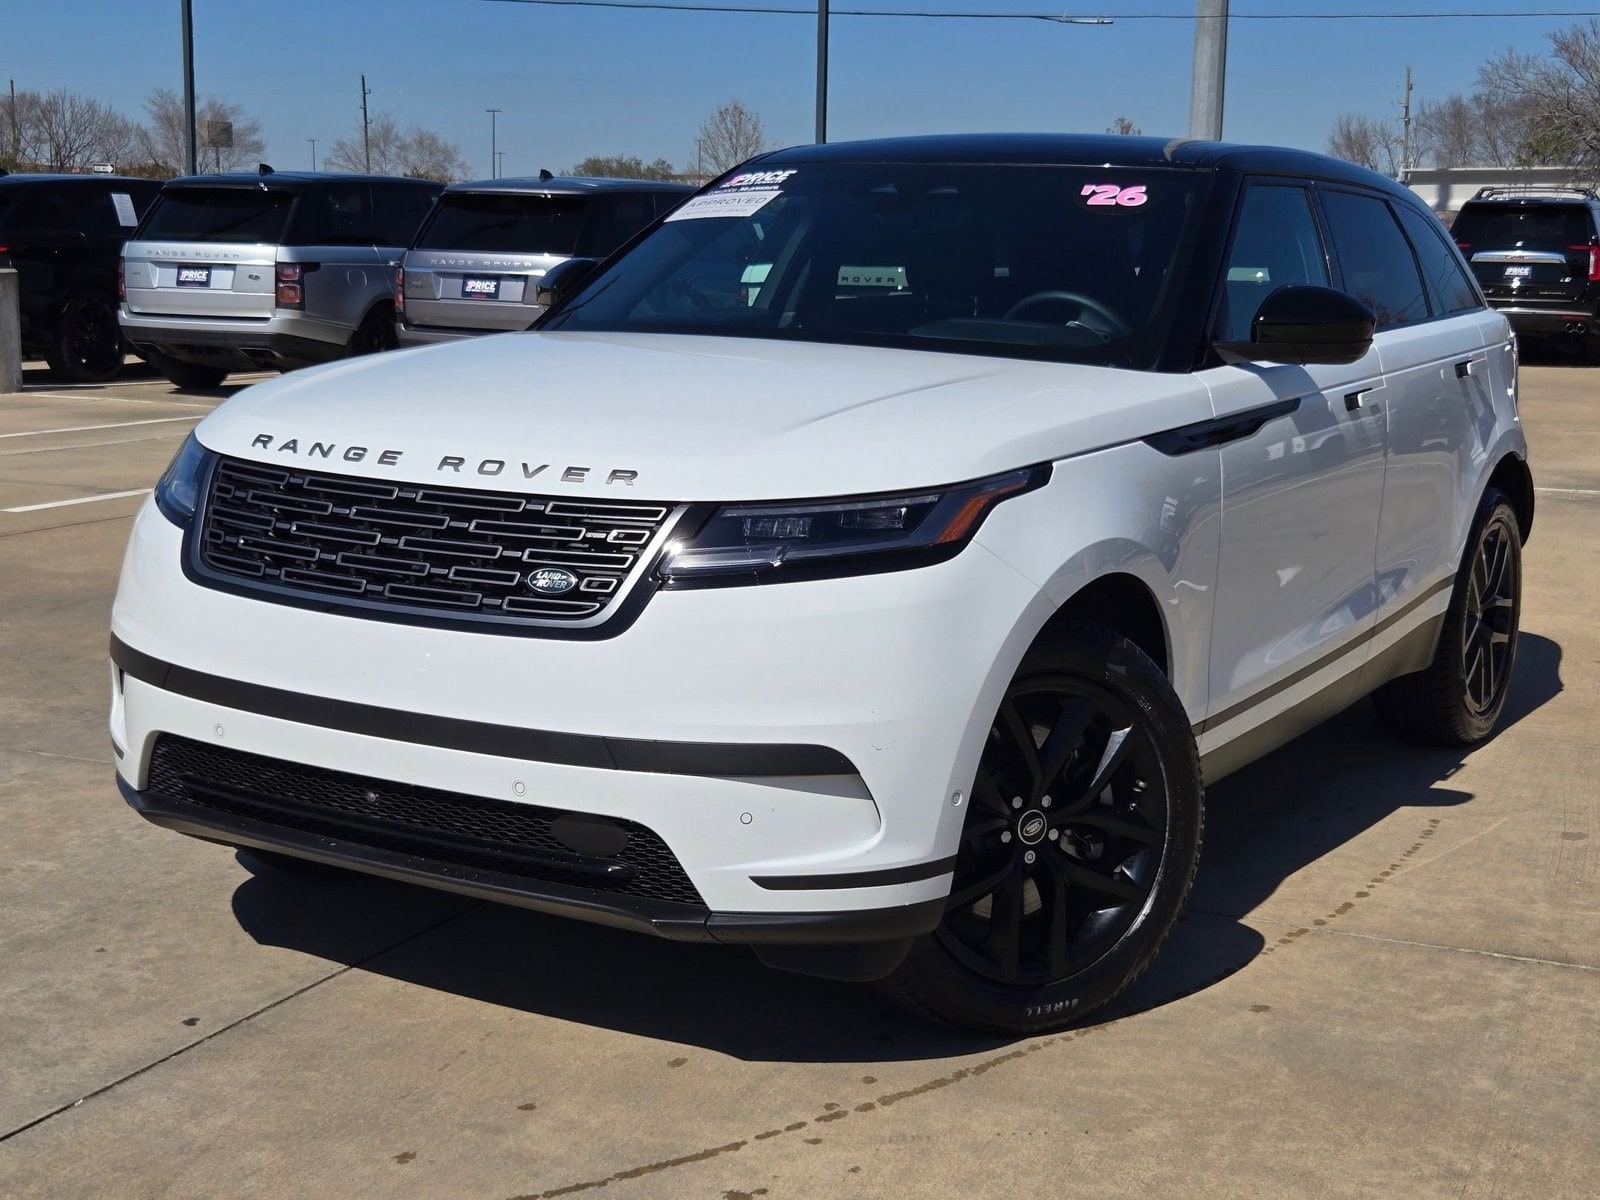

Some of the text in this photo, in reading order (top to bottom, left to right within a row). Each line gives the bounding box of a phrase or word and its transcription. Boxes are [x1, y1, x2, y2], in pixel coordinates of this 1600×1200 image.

[1080, 184, 1148, 206] '26
[689, 197, 768, 208] APPROVED
[251, 433, 639, 487] RANGE ROVER
[536, 571, 562, 580] LAND
[536, 578, 568, 589] ROVER
